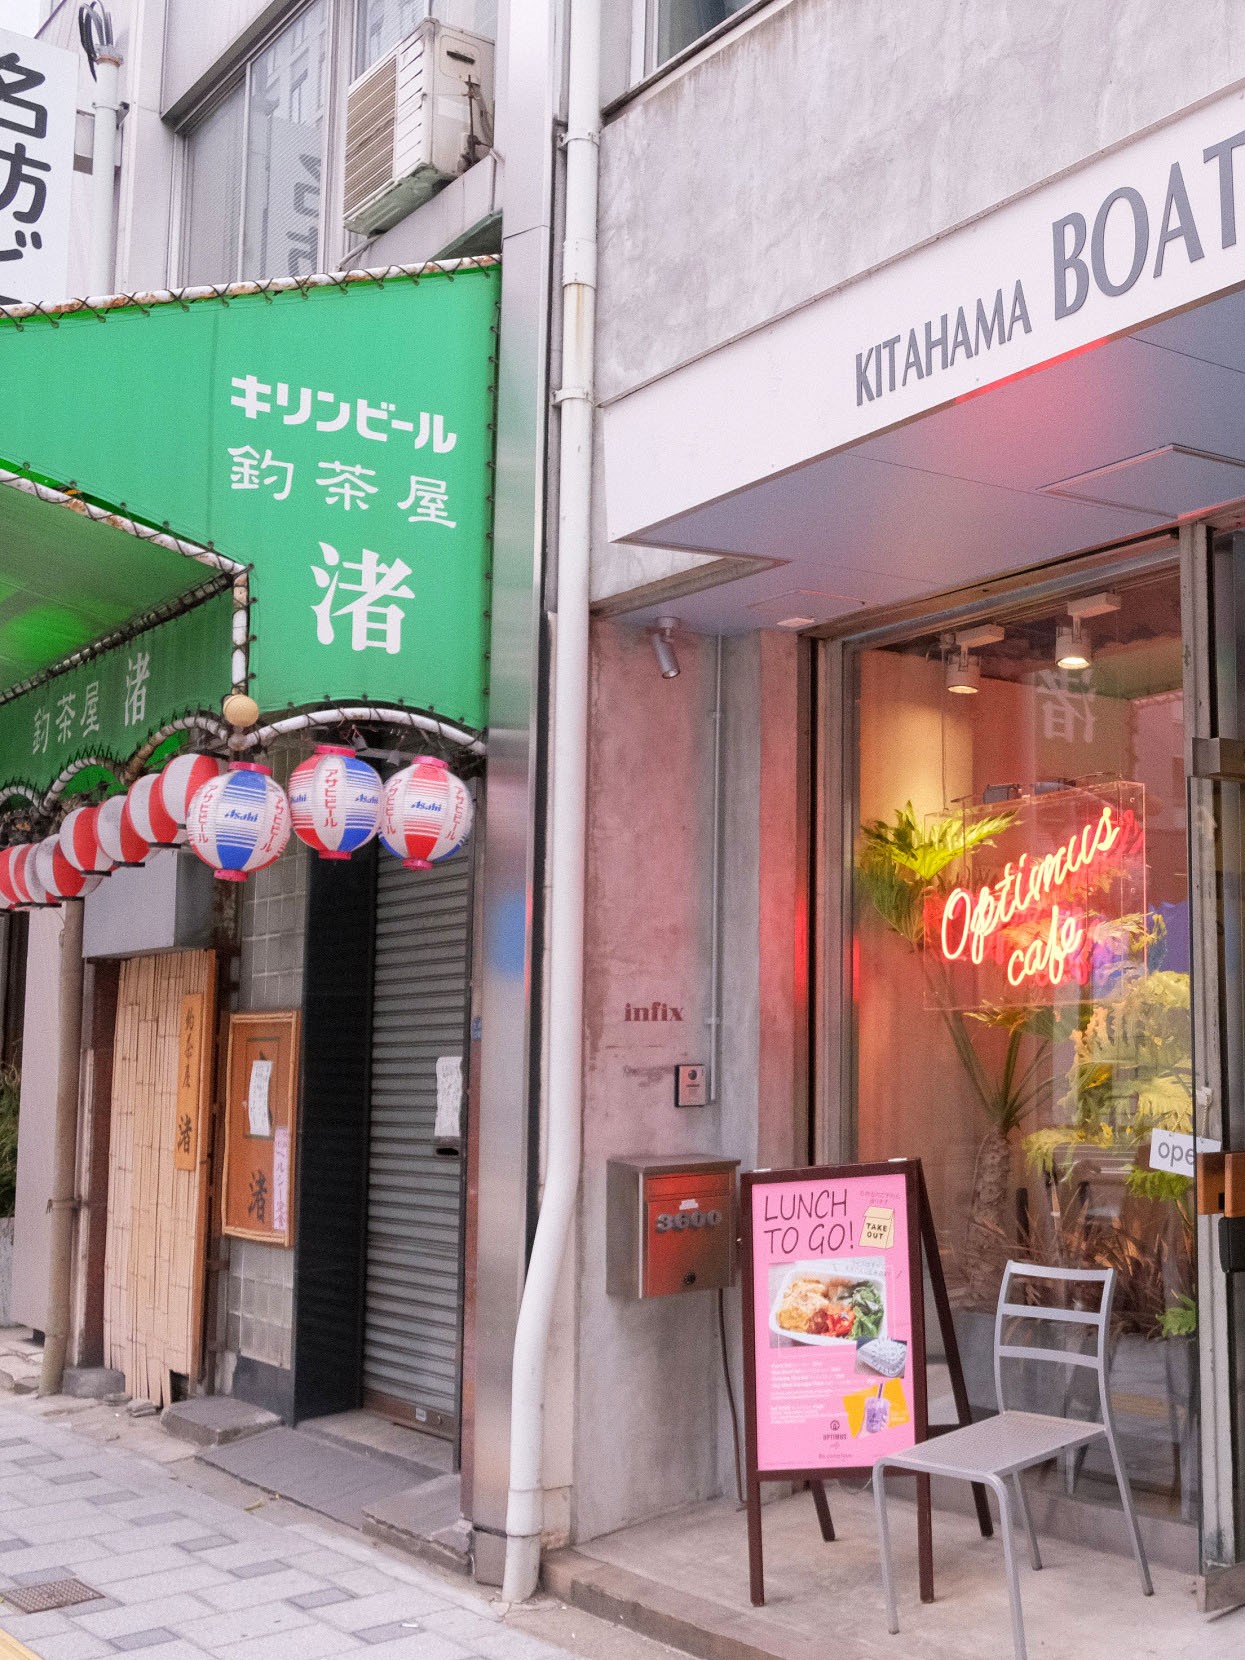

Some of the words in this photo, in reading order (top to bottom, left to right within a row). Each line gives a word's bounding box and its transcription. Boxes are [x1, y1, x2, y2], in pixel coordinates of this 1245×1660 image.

[856, 279, 1032, 406] KITAHAMA
[230, 374, 457, 453] キリンビール
[310, 541, 416, 655] 渚
[32, 682, 100, 755] 釣茶屋
[124, 651, 151, 727] 渚
[324, 769, 339, 827] アサヒビール
[355, 794, 379, 804] Asahi
[411, 801, 442, 812] Asahi
[224, 809, 258, 822] Asahi
[1007, 905, 1083, 987] cafe
[624, 1002, 684, 1021] infix
[764, 1189, 848, 1222] LUNCH
[764, 1226, 799, 1254] TO
[808, 1220, 854, 1254] GO!
[866, 1222, 888, 1232] TAKE
[867, 1231, 884, 1240] OUT
[823, 1433, 847, 1441] OPTIMUS
